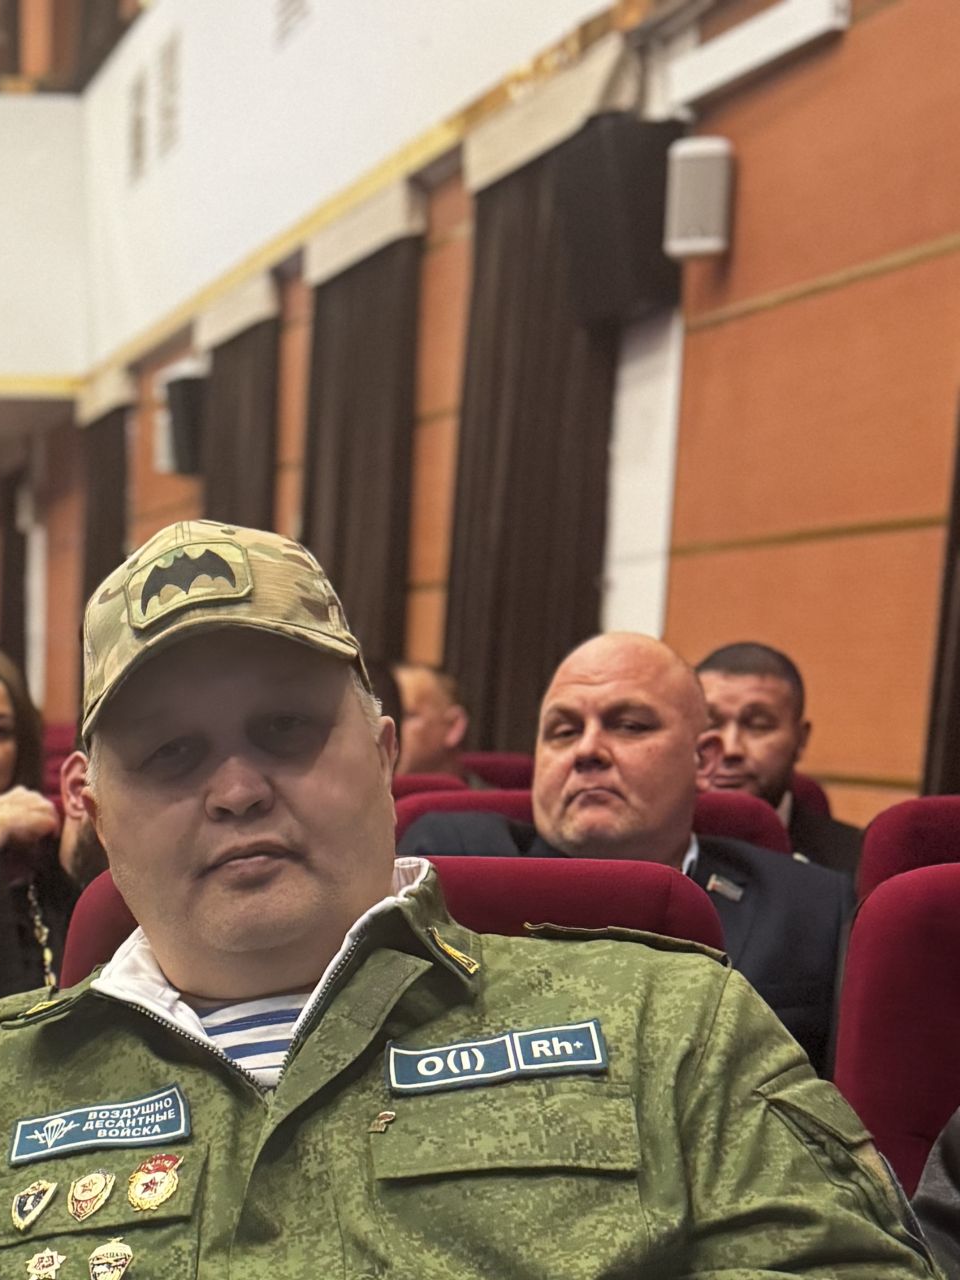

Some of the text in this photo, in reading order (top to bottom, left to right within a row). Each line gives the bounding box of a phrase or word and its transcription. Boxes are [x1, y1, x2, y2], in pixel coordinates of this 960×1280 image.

[531, 1037, 583, 1058] Rh+
[88, 1097, 173, 1120] ВОЗДУШНО
[82, 1109, 176, 1131] ДЕСАНТНЫЕ
[97, 1125, 161, 1138] ВОЙСКА
